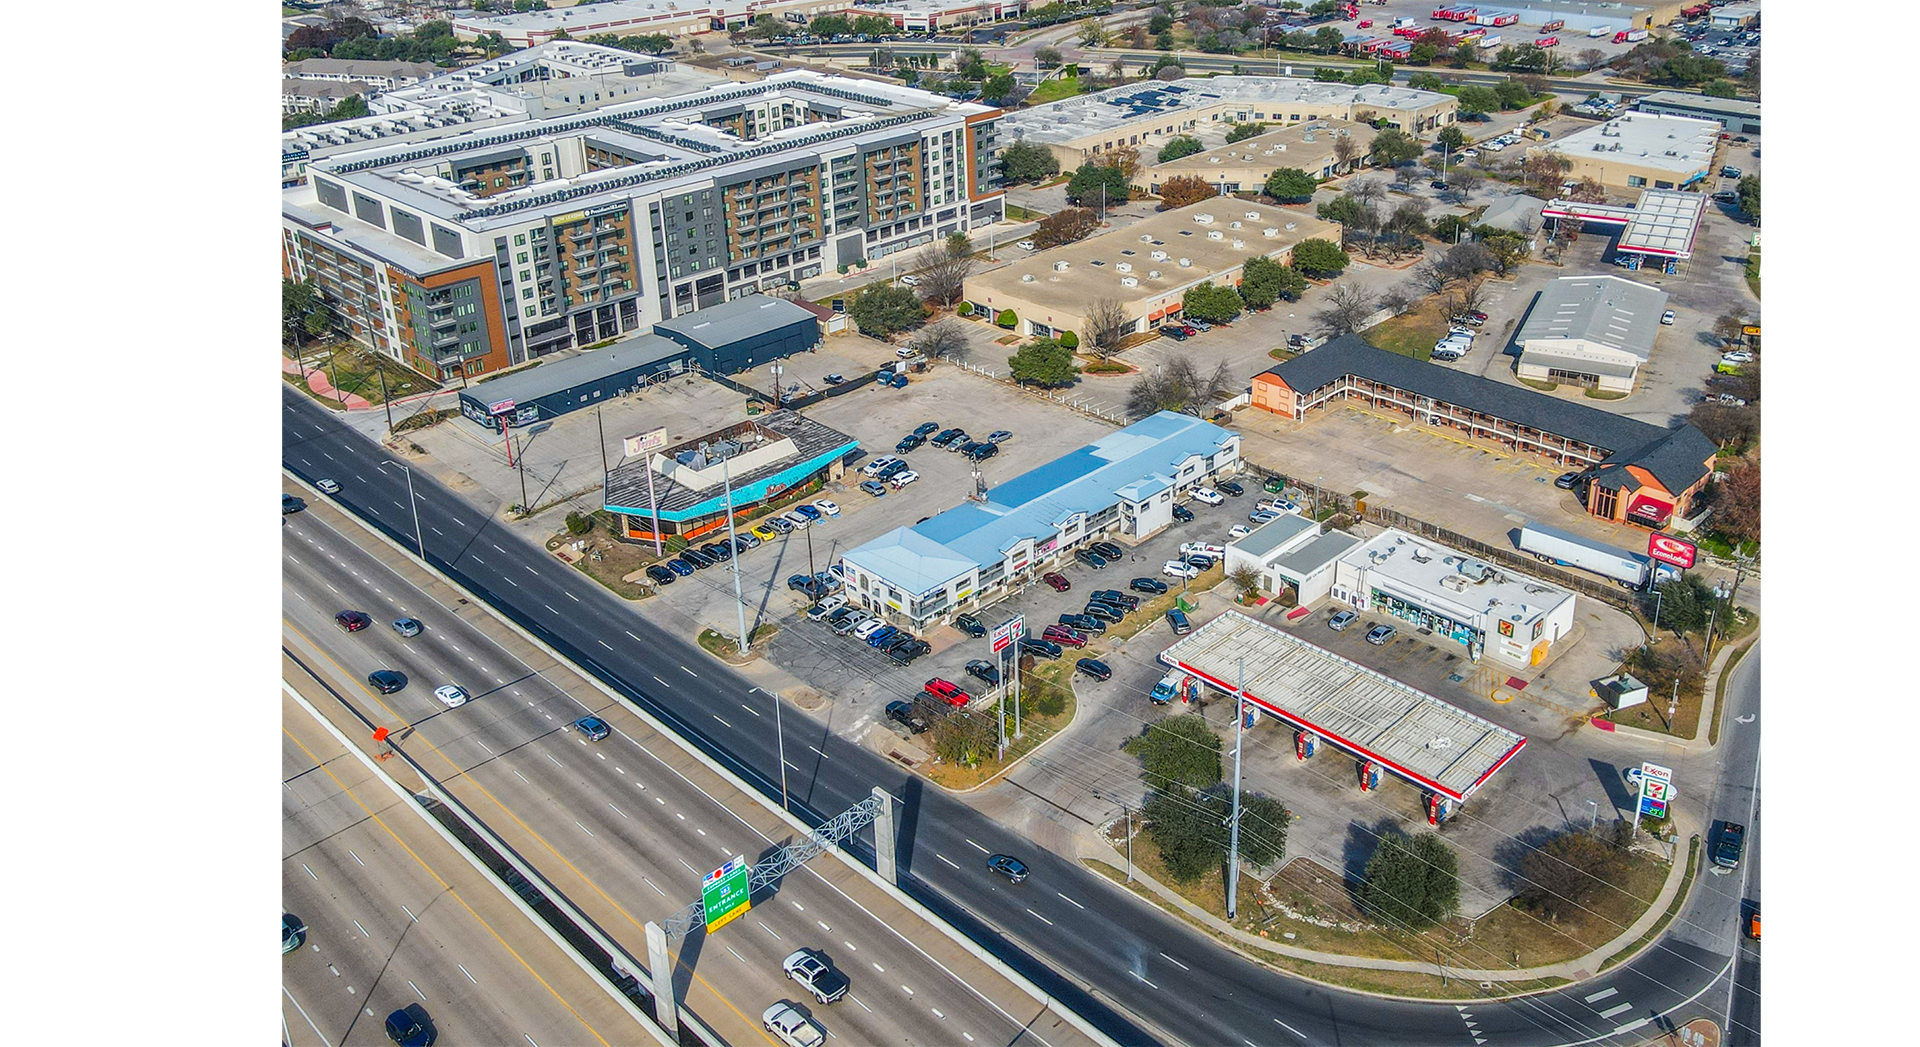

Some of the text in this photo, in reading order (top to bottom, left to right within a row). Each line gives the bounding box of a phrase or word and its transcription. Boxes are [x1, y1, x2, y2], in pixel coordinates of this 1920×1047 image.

[993, 626, 1009, 638] Exxon
[1644, 765, 1669, 777] Exxon
[708, 887, 744, 913] ENTRANCE
[714, 908, 743, 927] LEFT LANE
